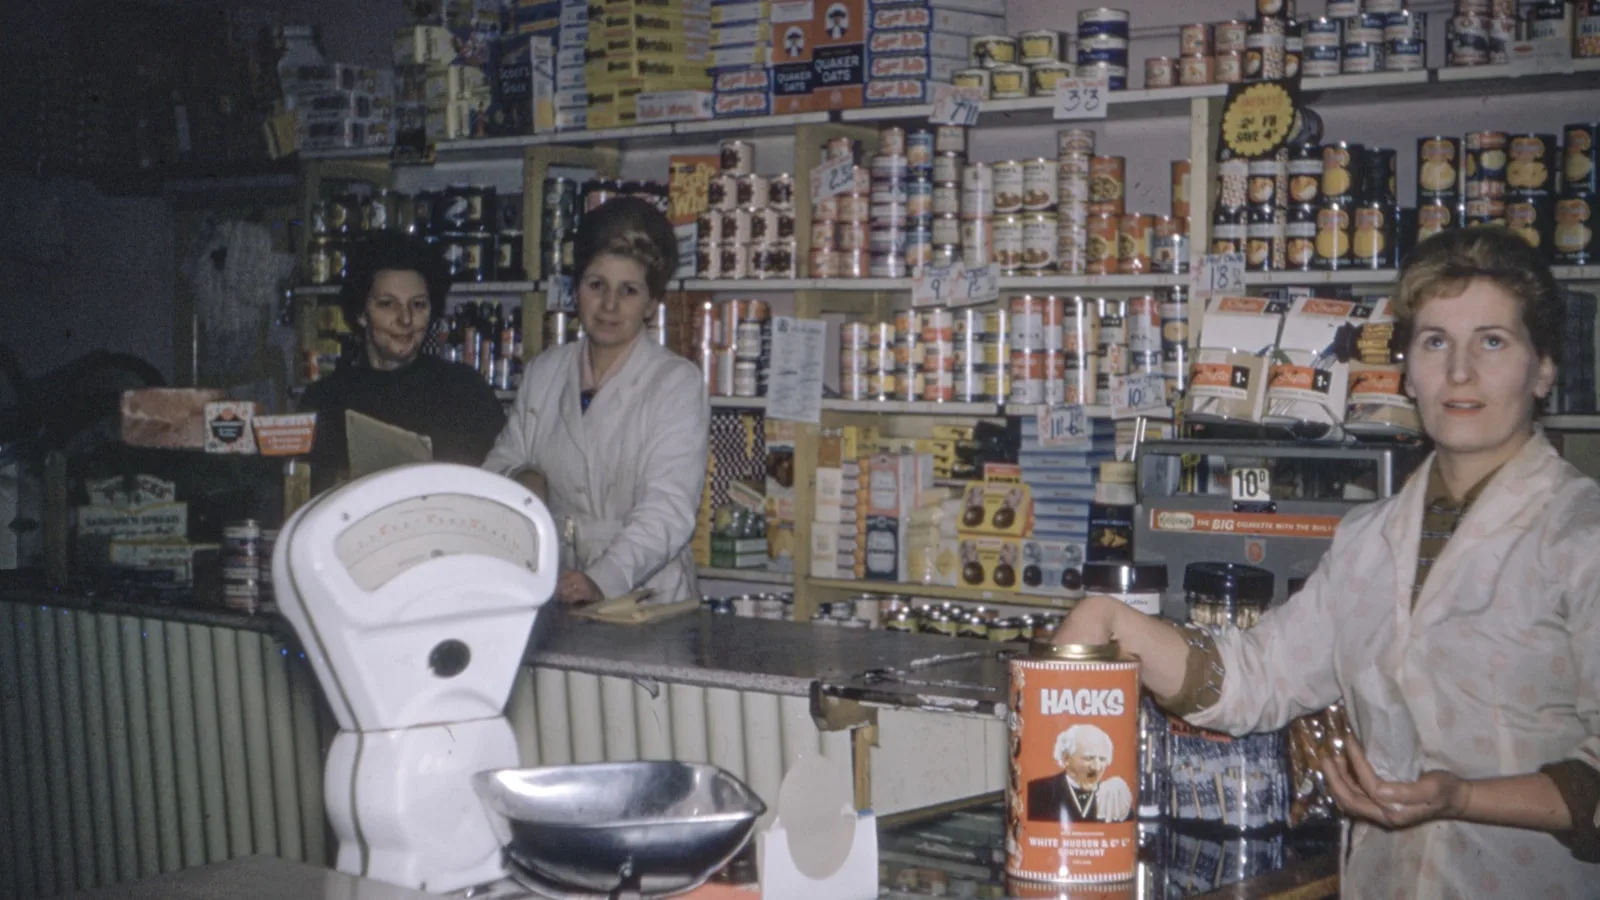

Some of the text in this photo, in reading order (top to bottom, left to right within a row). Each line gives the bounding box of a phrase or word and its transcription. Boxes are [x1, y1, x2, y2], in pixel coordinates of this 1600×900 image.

[814, 56, 859, 73] QUAKER
[777, 72, 811, 83] QUAKER
[823, 70, 850, 82] OATS
[784, 83, 805, 92] OATS
[1211, 519, 1235, 531] BIG
[1041, 688, 1125, 716] HACKS
[1029, 836, 1059, 848] WHITE
[1062, 838, 1100, 849] HUDSON
[1101, 839, 1109, 849] &
